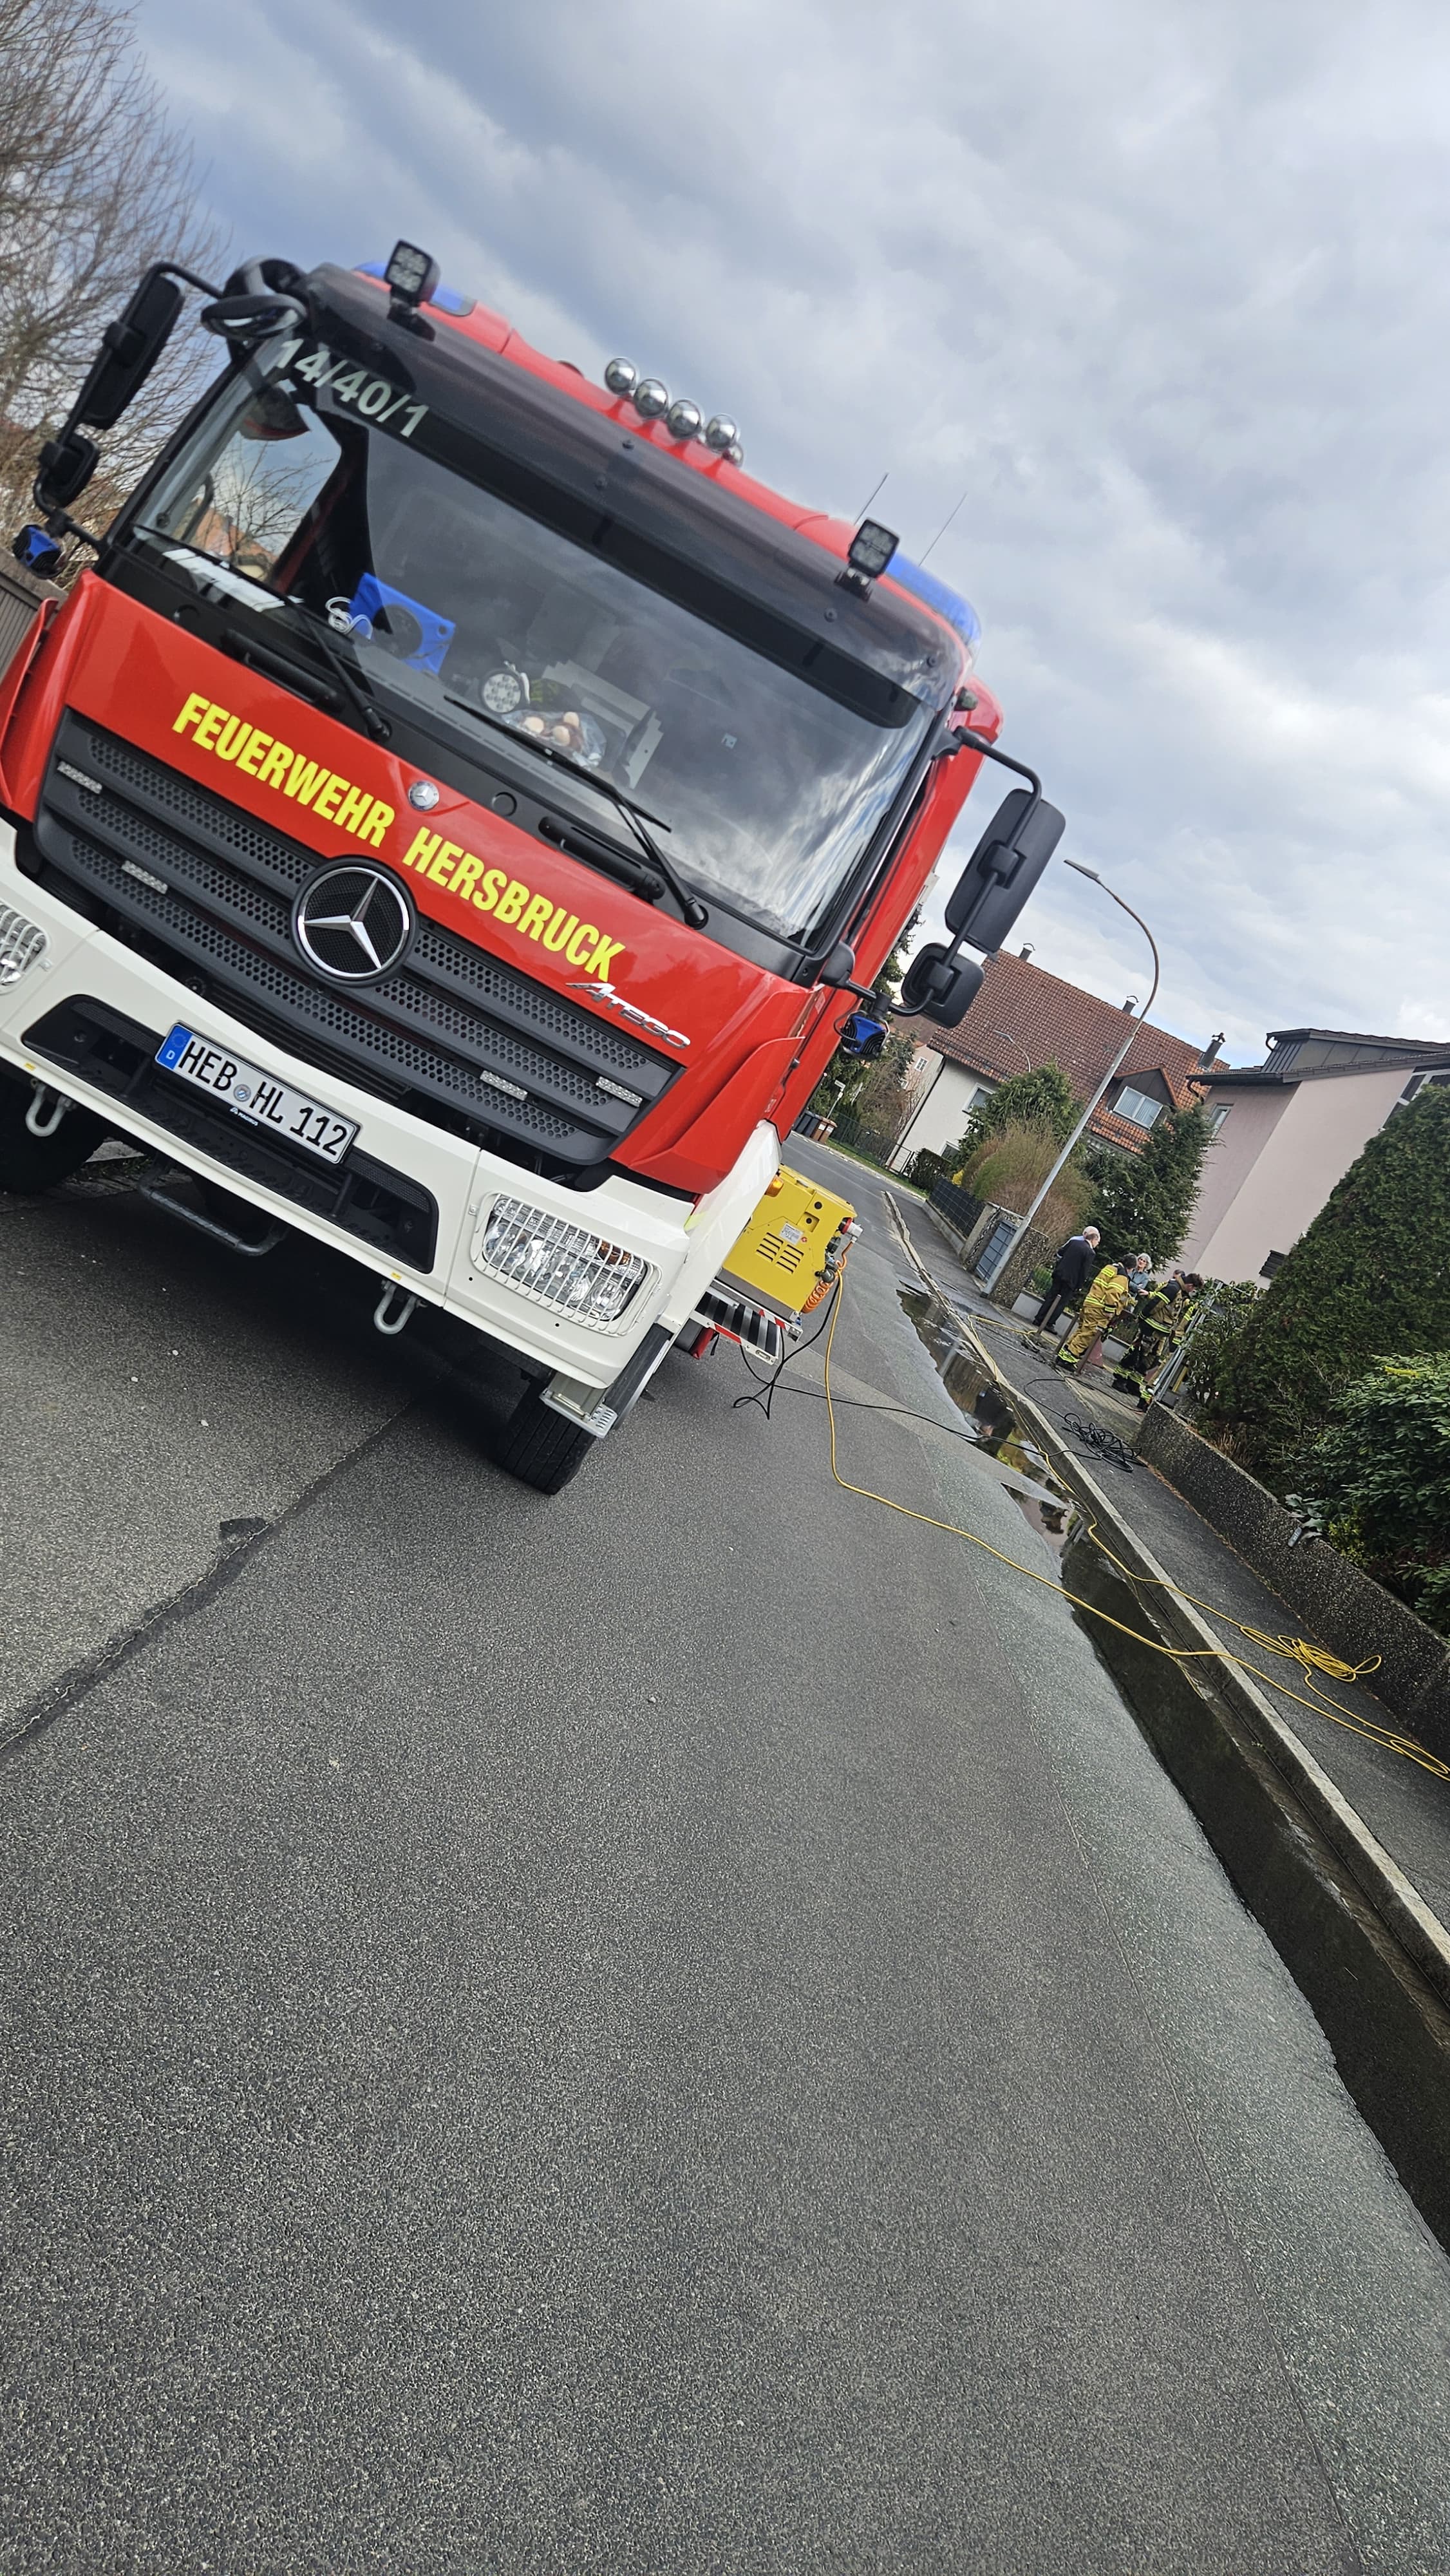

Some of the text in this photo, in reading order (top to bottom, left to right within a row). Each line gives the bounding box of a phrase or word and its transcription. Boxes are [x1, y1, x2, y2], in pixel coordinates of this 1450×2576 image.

[277, 339, 429, 438] 14/40/1
[172, 692, 625, 982] FEUERWEHR HERSBRUCK
[165, 1050, 176, 1060] D
[178, 1041, 347, 1155] HEB HL 112
